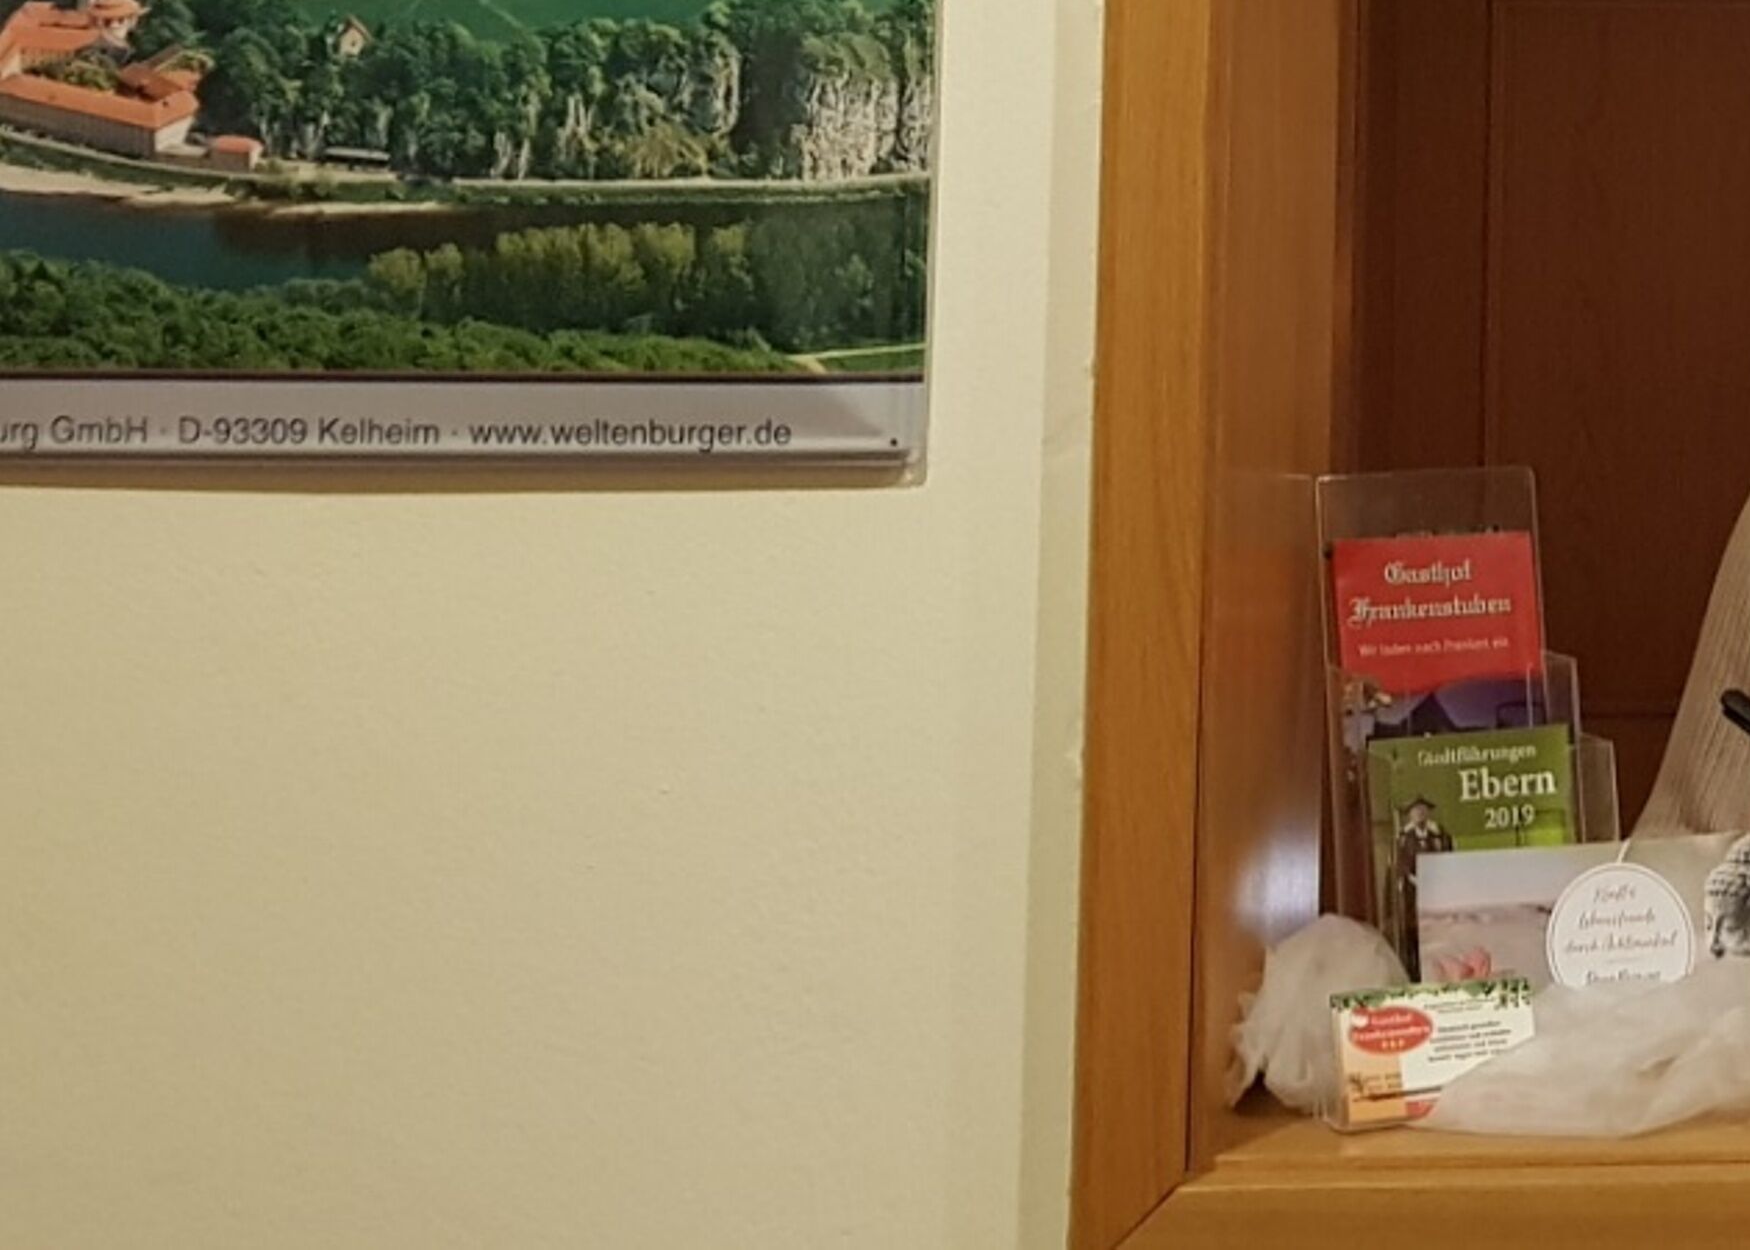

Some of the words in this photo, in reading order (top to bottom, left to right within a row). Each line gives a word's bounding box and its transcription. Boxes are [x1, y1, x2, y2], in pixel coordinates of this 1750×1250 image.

[51, 415, 148, 445] GmbH
[178, 416, 308, 445] D-93309
[318, 417, 440, 445] Kelheim
[468, 418, 792, 453] www.weltenburger.de
[1384, 559, 1472, 587] Gasthof
[1349, 593, 1512, 629] Frankenstuben
[1458, 765, 1557, 800] Ebern
[1484, 803, 1536, 829] 2019
